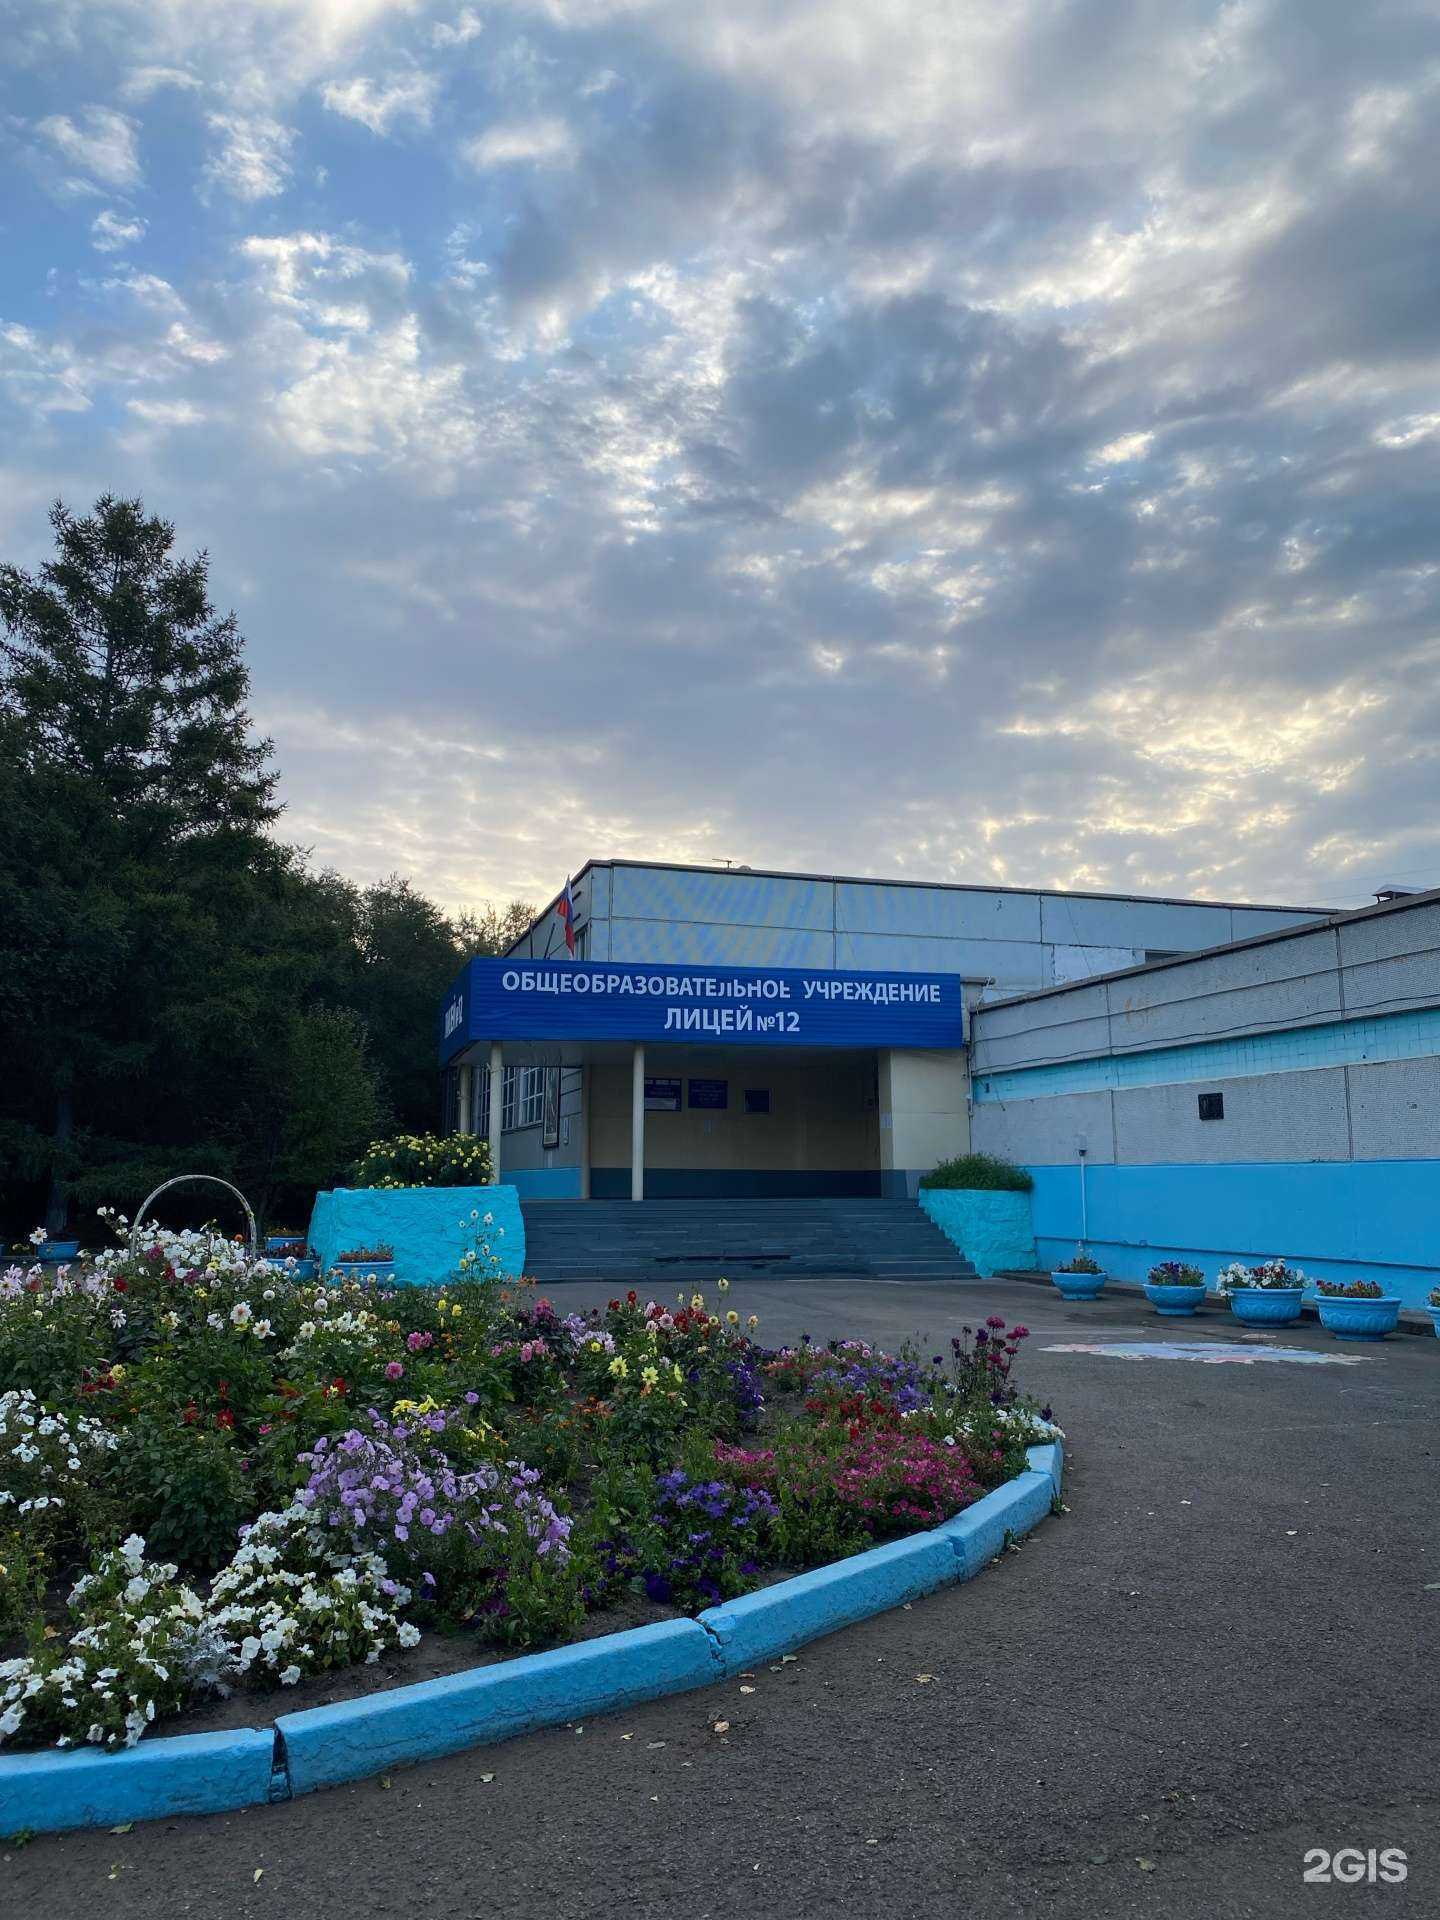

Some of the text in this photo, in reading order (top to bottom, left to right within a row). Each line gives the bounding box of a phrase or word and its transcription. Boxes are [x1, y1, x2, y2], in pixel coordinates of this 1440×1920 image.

[803, 980, 941, 1005] УЧРЕЖДЕНИЕ
[664, 1004, 800, 1035] ЛИЦЕЙ №12
